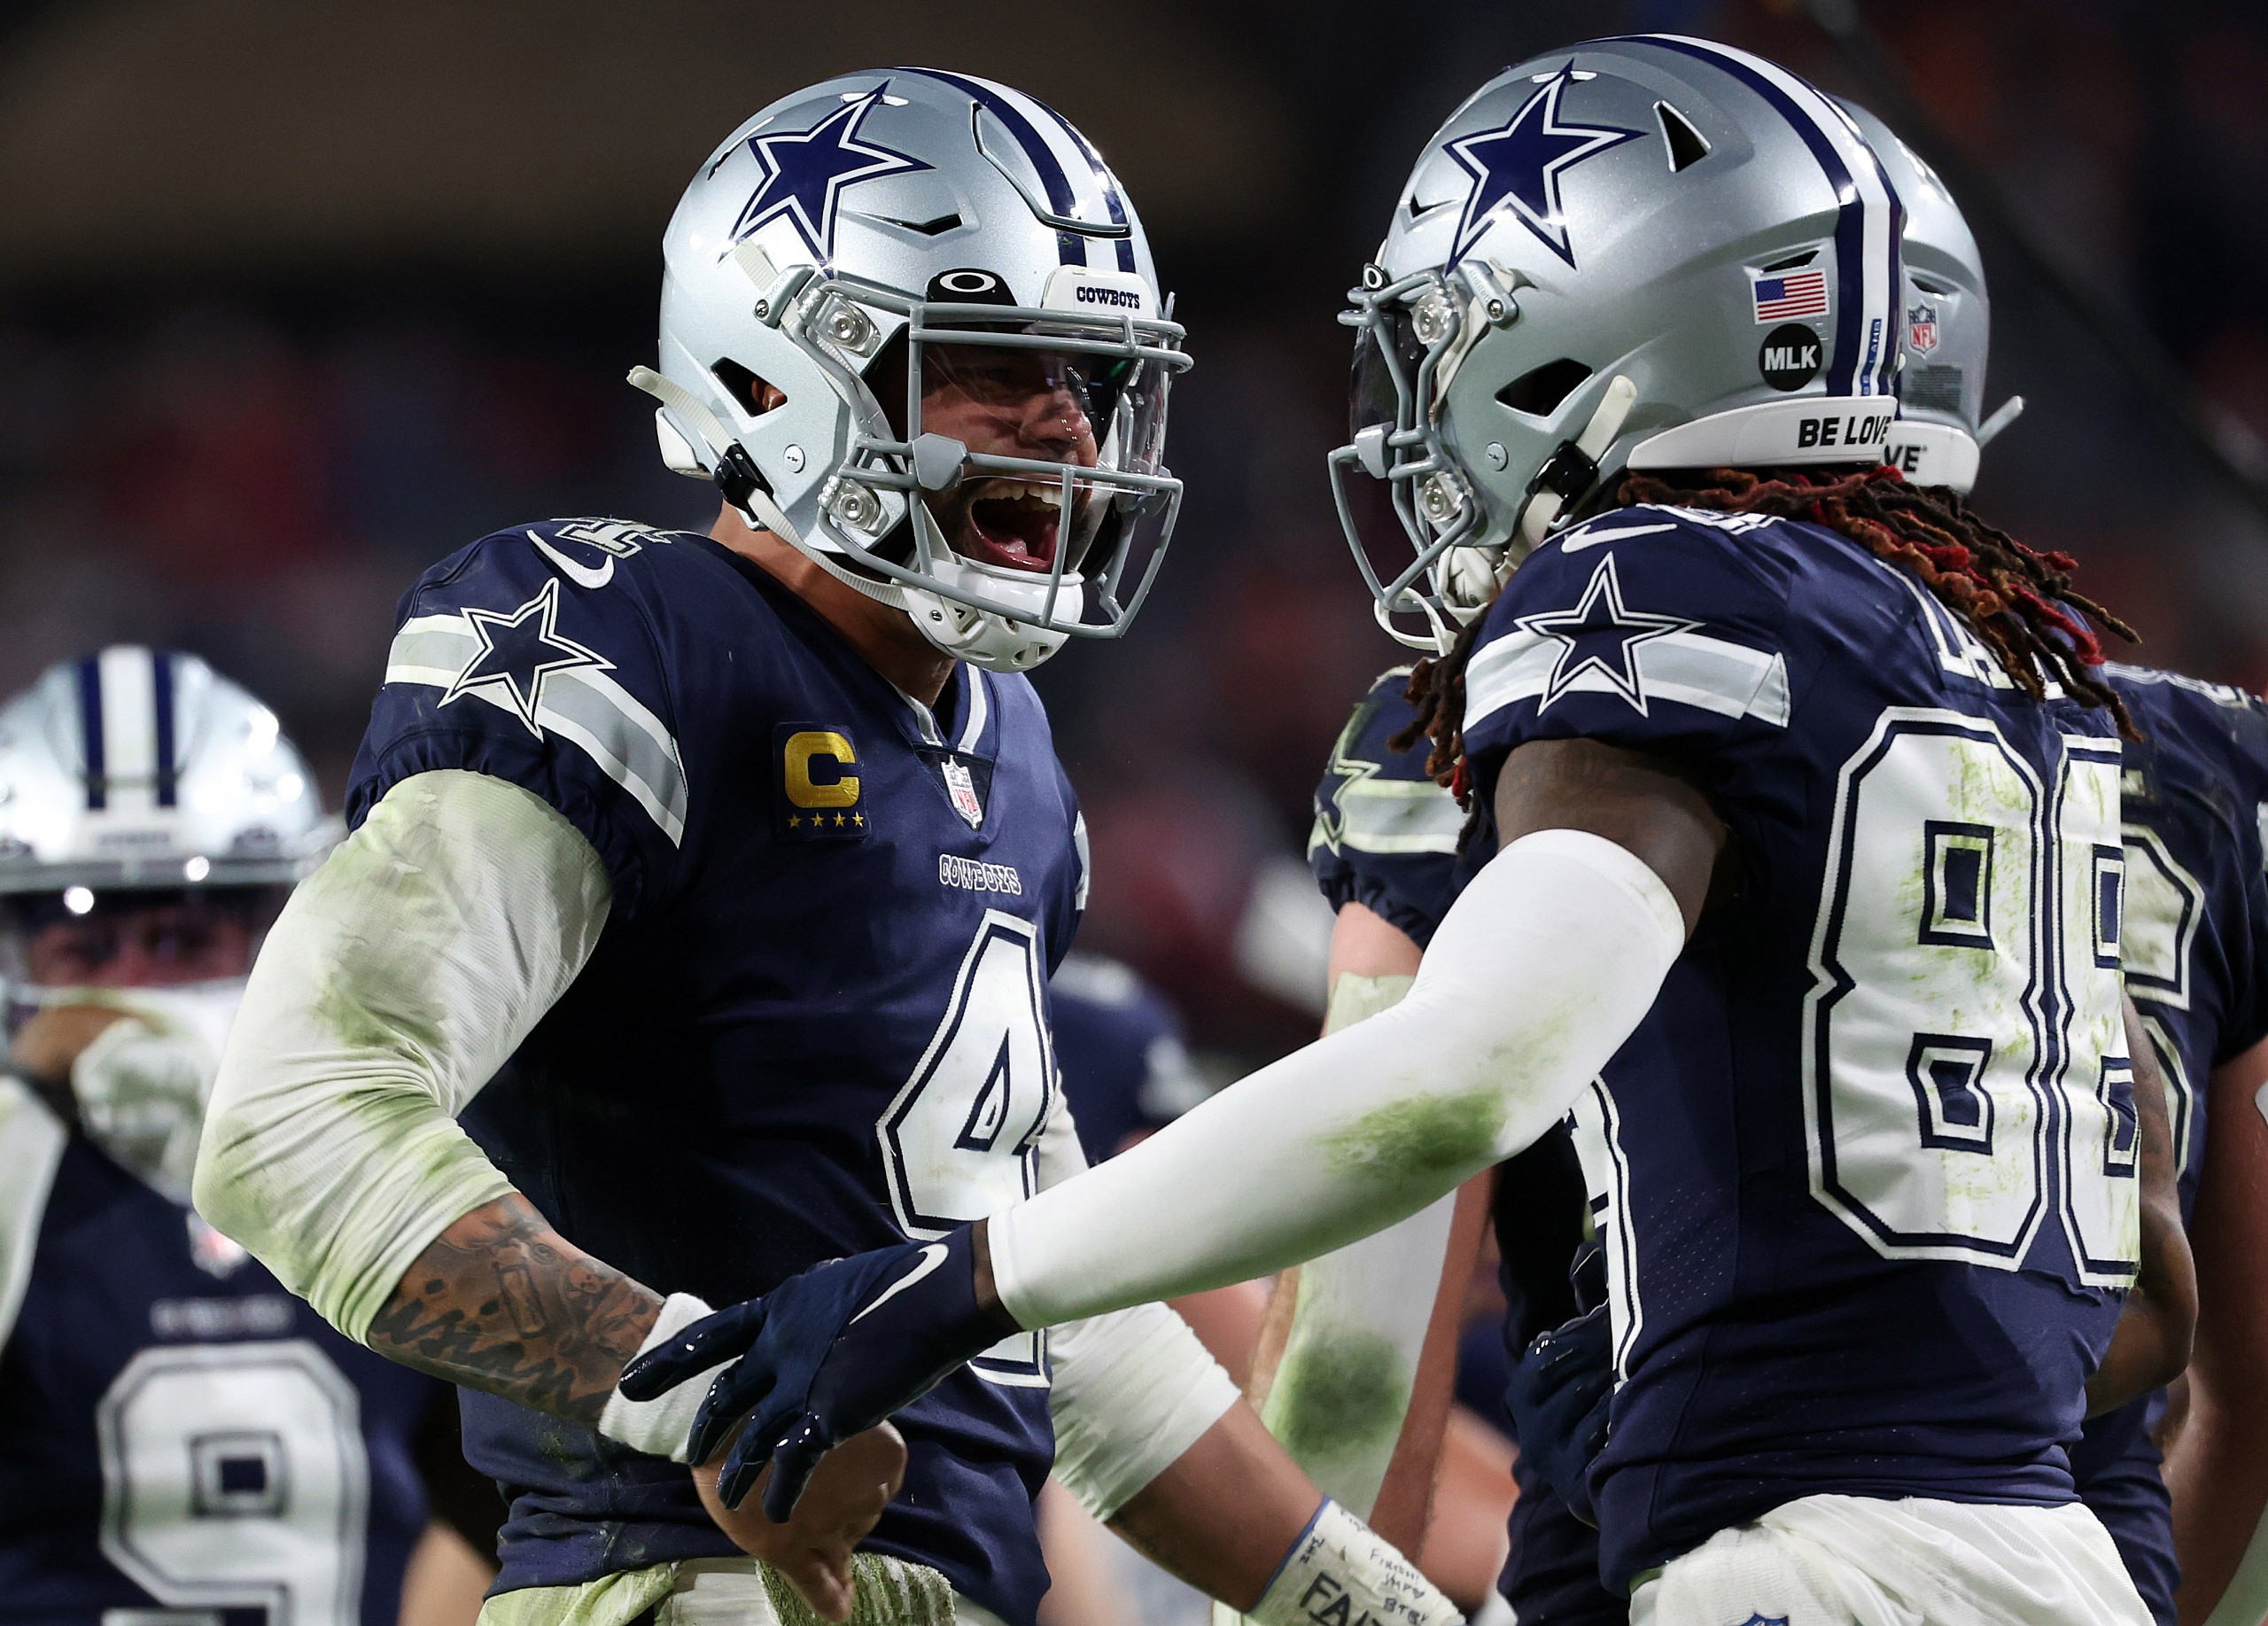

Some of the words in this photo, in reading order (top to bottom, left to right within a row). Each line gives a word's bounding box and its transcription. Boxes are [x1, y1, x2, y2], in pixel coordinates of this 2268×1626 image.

[1076, 285, 1141, 310] COWBOYS
[1911, 323, 1935, 348] NFL
[1764, 345, 1818, 371] MLK
[1798, 417, 1840, 448] BE
[1844, 416, 1892, 445] LOVE
[784, 731, 860, 809] C
[939, 853, 1022, 896] COWBOYS
[1801, 705, 2140, 1288] 88
[875, 908, 1052, 1389] 4
[96, 1339, 372, 1626] 9
